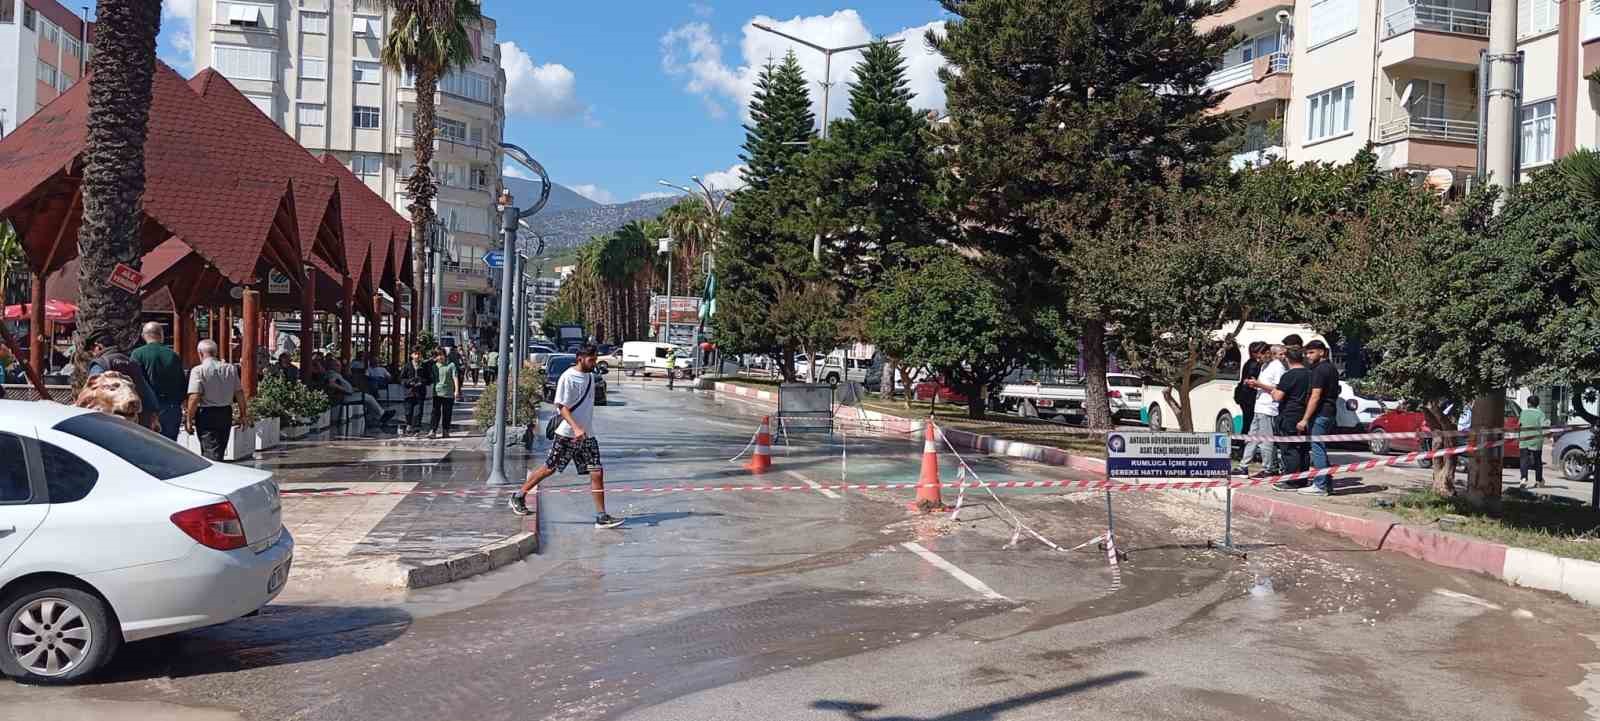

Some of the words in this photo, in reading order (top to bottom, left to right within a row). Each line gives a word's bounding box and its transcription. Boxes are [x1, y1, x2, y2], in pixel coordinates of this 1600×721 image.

[1129, 436, 1150, 444] ANTALYA
[1168, 459, 1186, 467] İÇME
[1111, 469, 1139, 477] ŞEBEKE
[1190, 469, 1228, 477] ÇALIŞMASI
